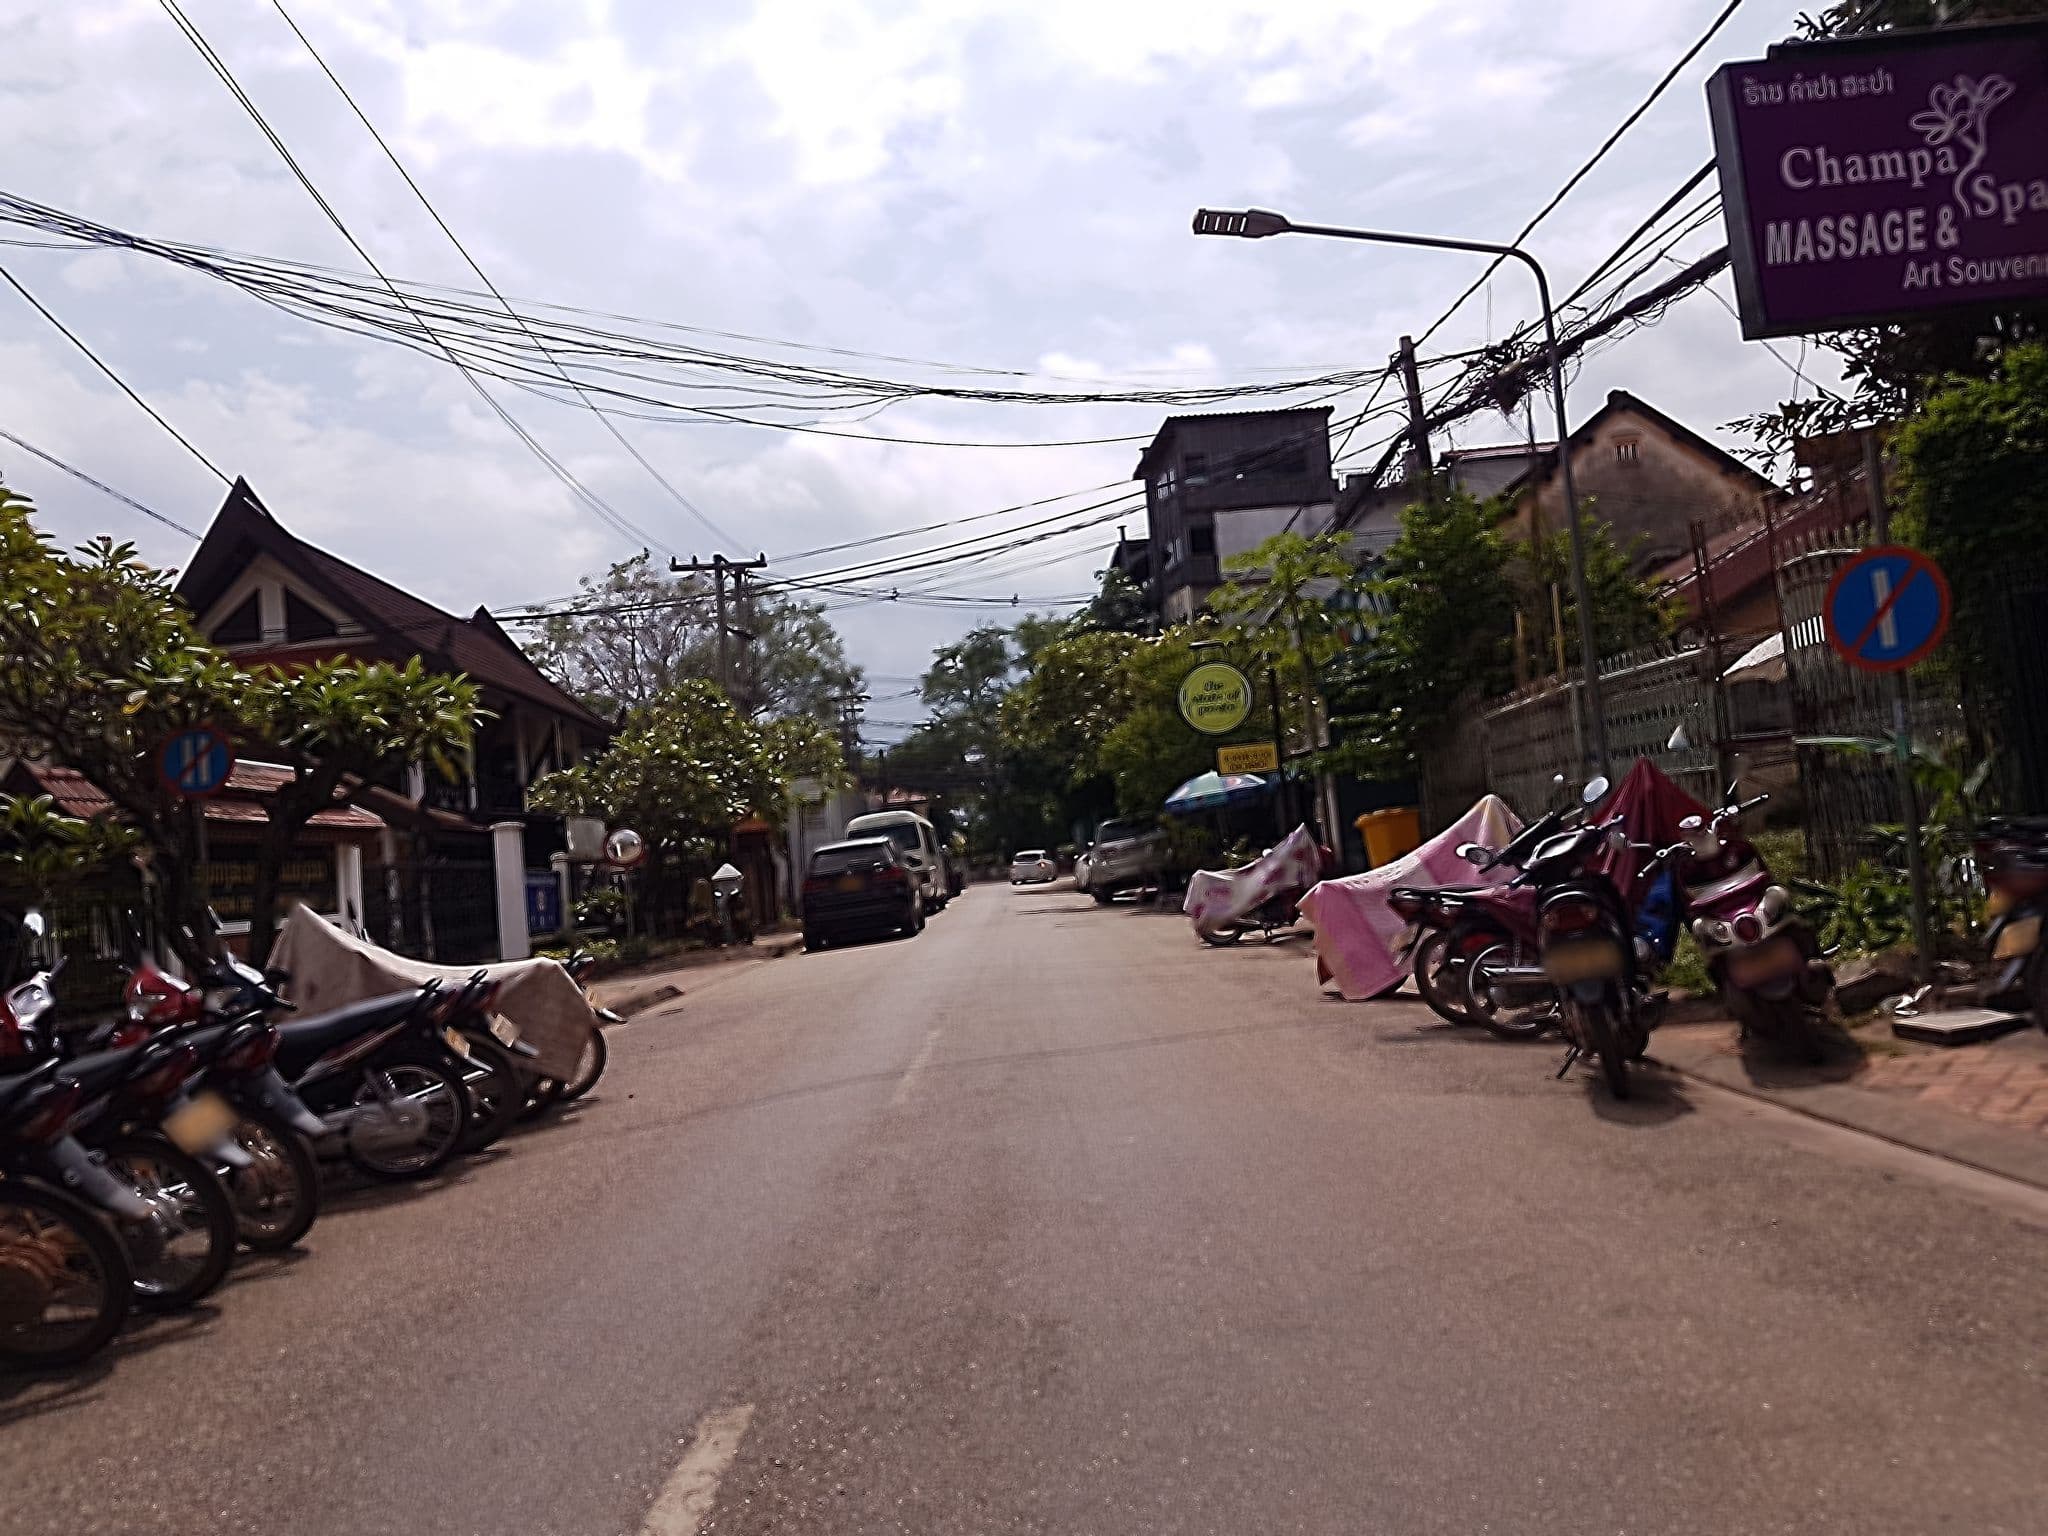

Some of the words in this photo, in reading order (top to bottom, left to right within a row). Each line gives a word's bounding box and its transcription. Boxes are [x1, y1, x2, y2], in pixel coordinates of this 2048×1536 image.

[1780, 147, 1957, 188] Champa
[1971, 175, 2048, 224] Spa
[1766, 207, 1926, 264] MASSAGE
[1936, 205, 1959, 248] &
[1903, 261, 1941, 288] Art
